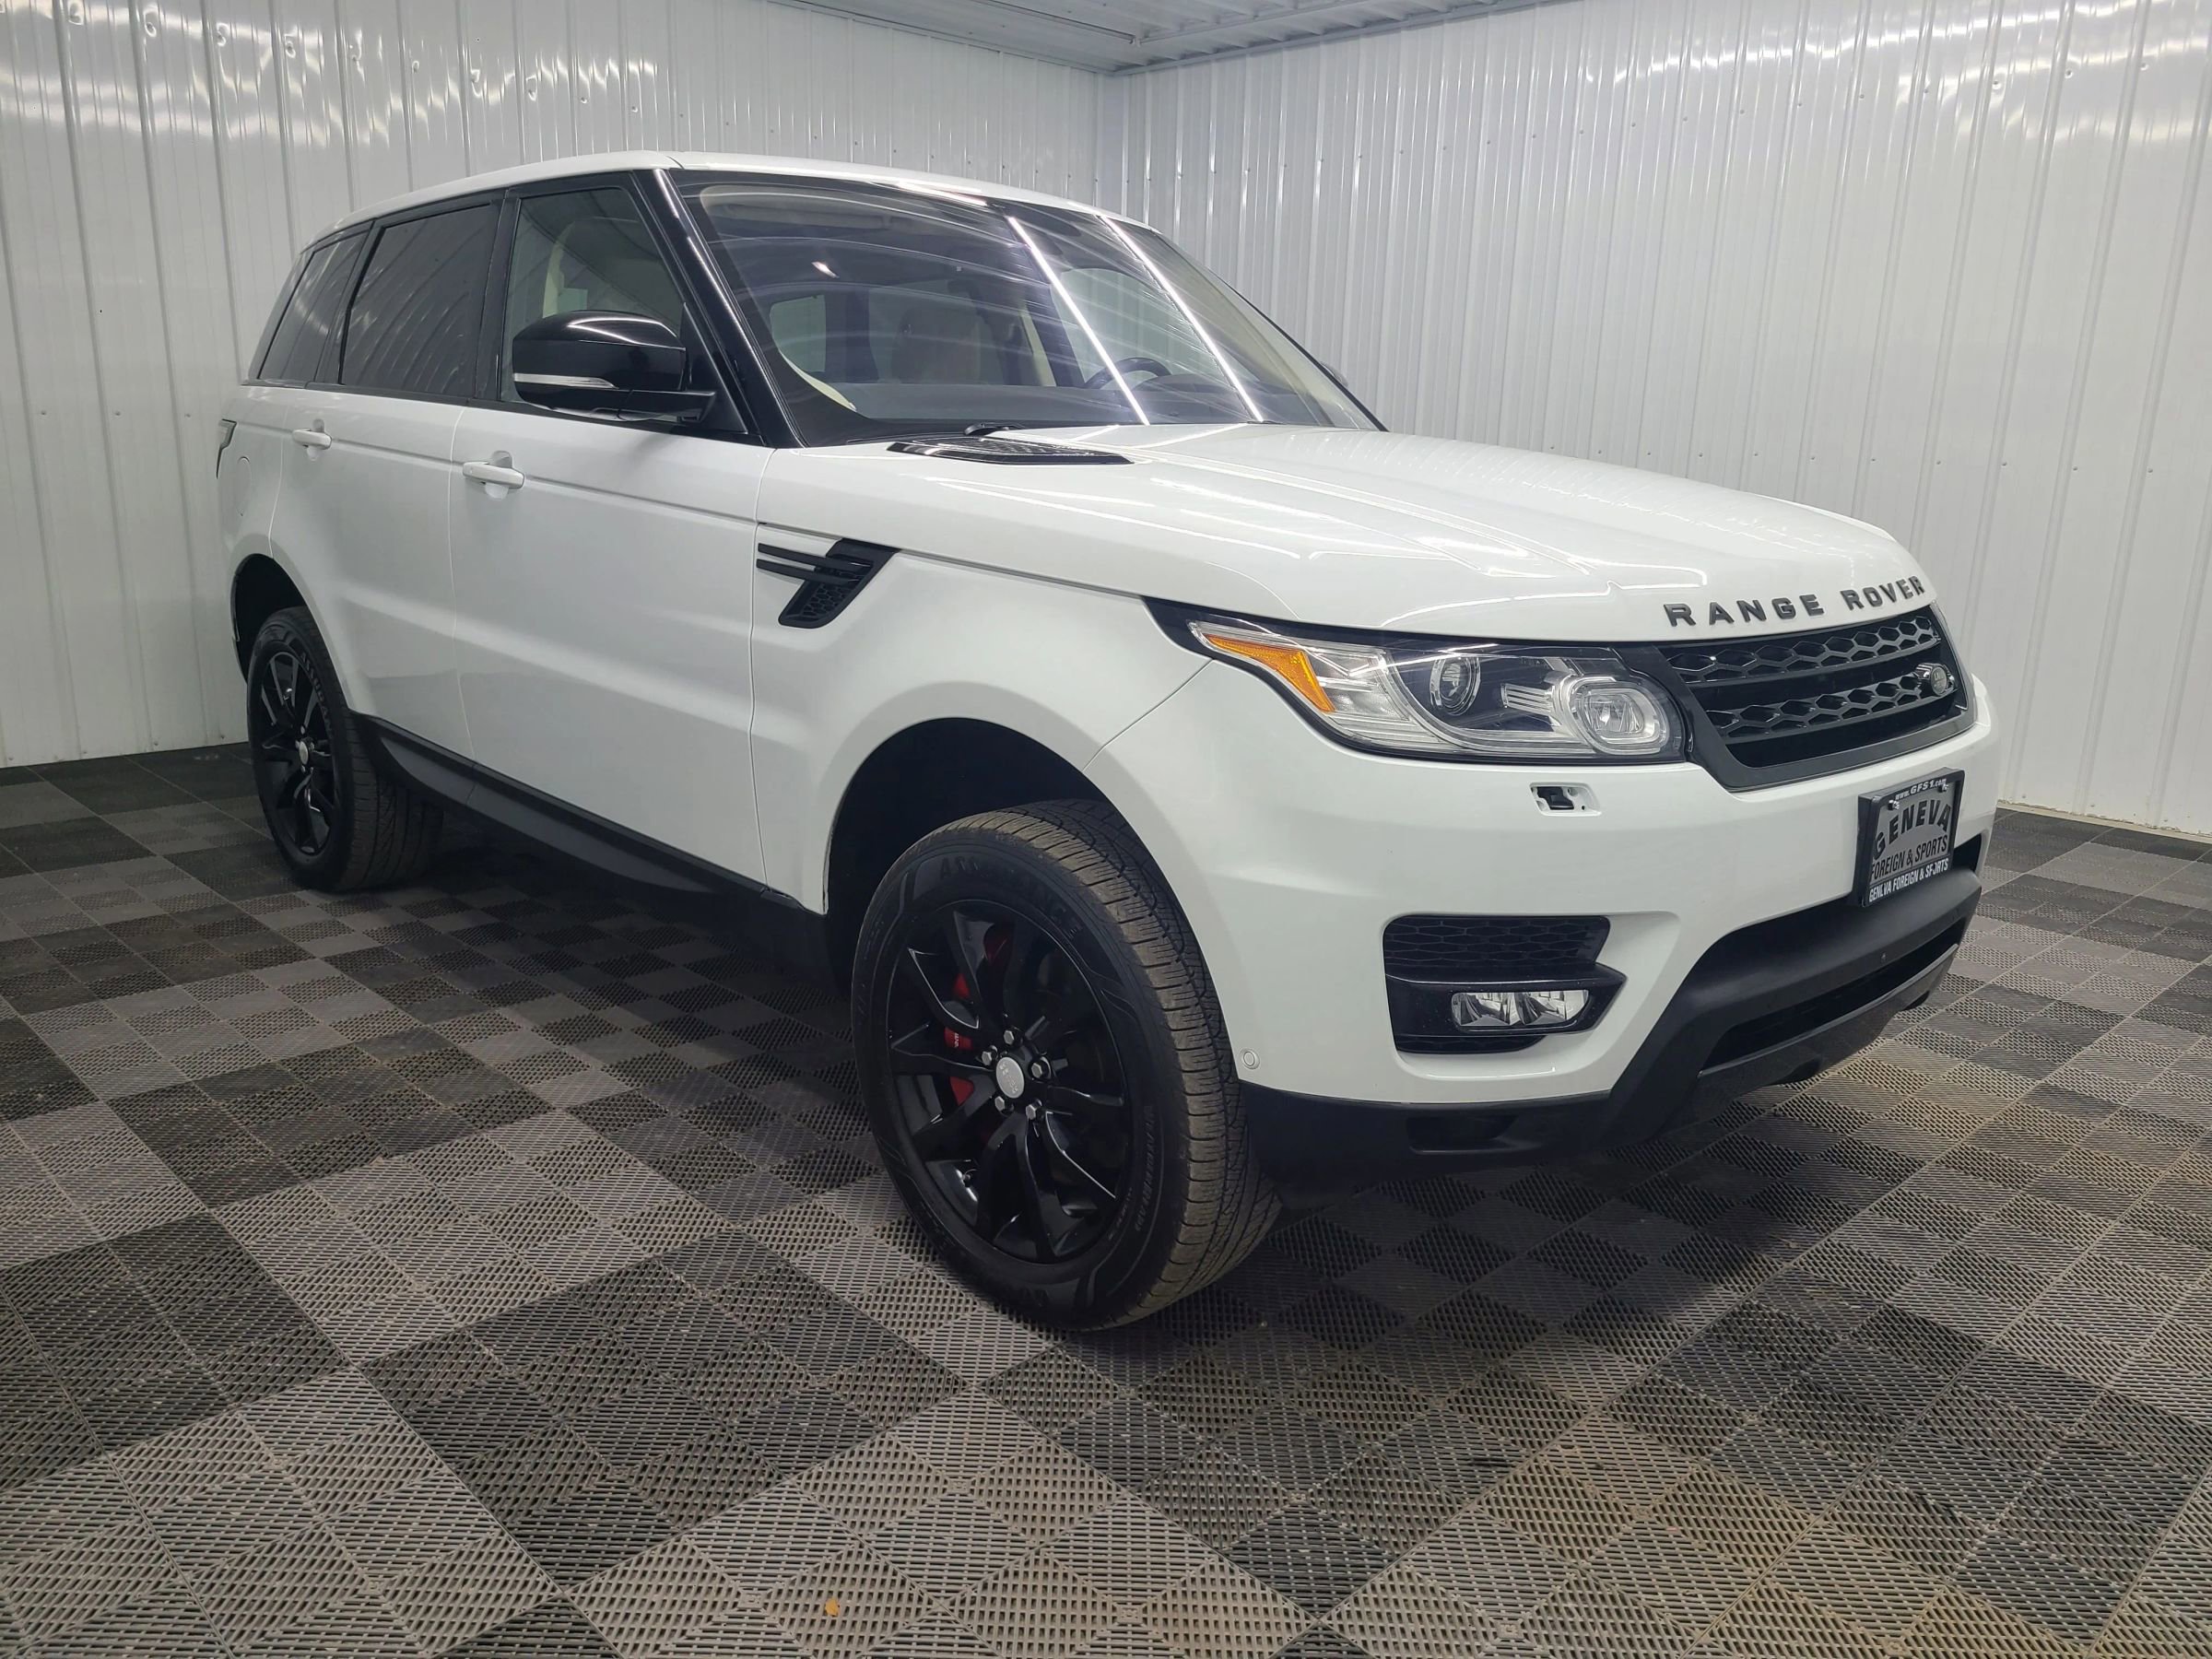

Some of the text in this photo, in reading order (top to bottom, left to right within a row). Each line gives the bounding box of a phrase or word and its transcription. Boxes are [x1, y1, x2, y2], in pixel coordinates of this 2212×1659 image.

[1664, 576, 1925, 627] RANGE ROVER
[1873, 799, 1951, 861] GENEVA
[1906, 848, 1913, 867] &
[1914, 834, 1948, 863] SPORTS
[1892, 868, 1920, 892] FOREIGN
[1919, 867, 1924, 881] &
